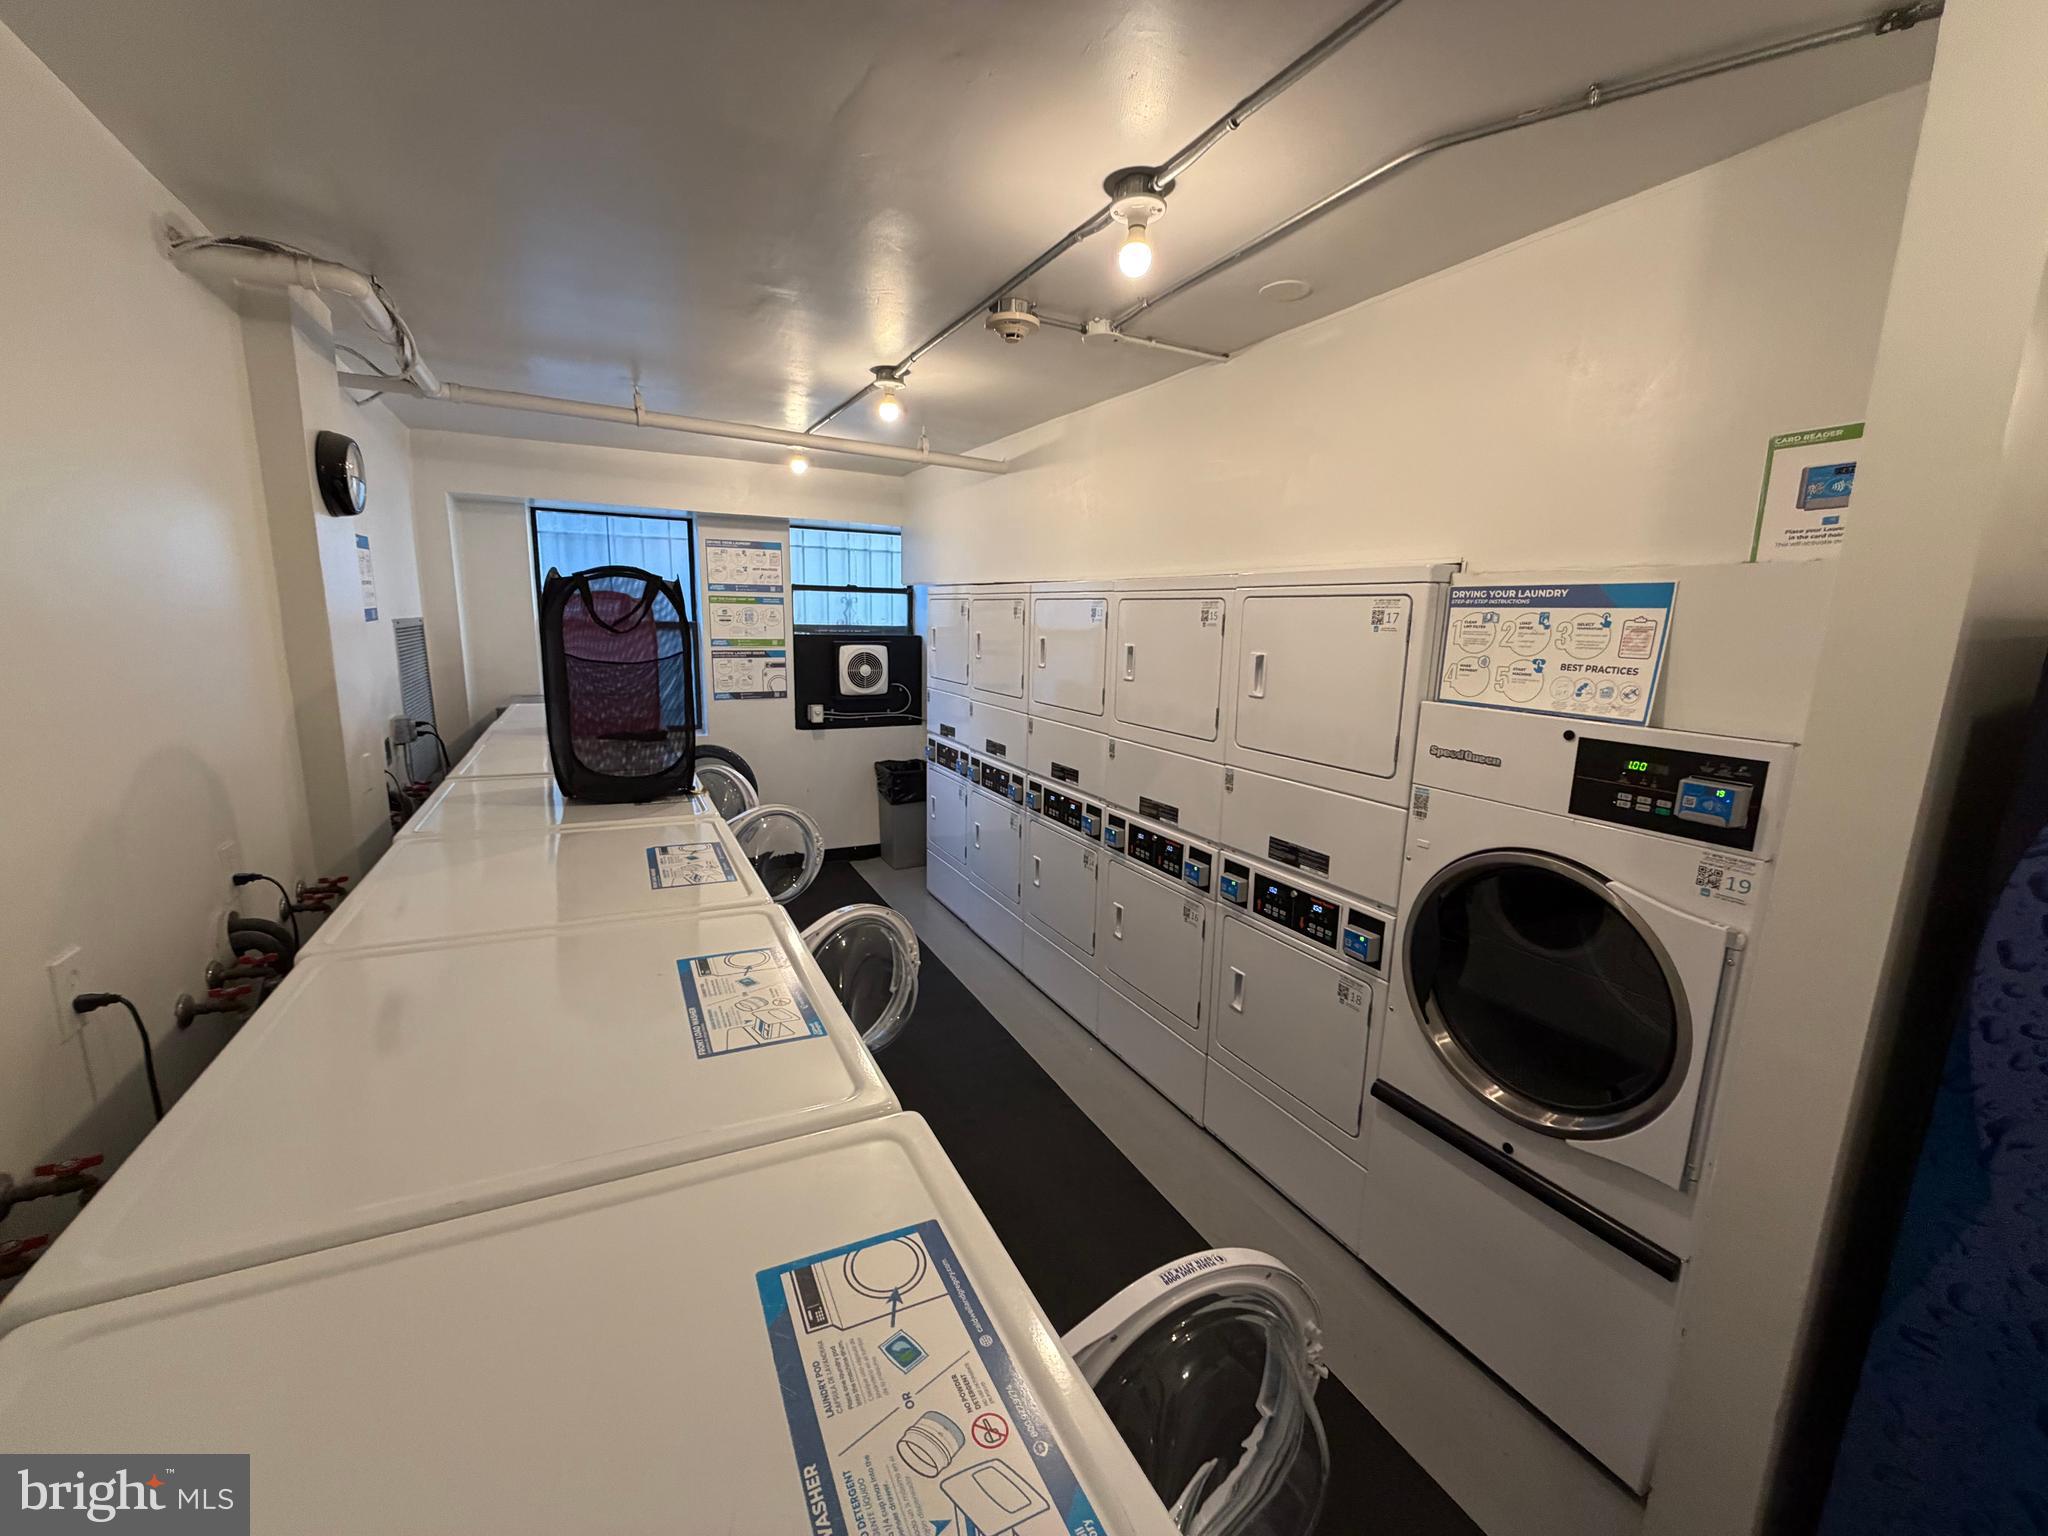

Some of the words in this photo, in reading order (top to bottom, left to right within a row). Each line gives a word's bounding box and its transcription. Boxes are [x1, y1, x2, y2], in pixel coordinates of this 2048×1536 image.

[1775, 435, 1801, 444] CARD
[1803, 429, 1844, 441] READER
[1452, 590, 1488, 599] DRYING
[1488, 589, 1517, 598] YOUR
[1517, 588, 1569, 598] LAUNDRY
[1386, 612, 1400, 625] 17
[1560, 663, 1585, 672] BEST
[1585, 664, 1640, 676] PRACTICES
[1429, 744, 1464, 760] Speed
[1464, 750, 1502, 767] Queen
[1628, 760, 1648, 772] 1.00
[1725, 876, 1751, 894] 19
[811, 1360, 823, 1379] POD
[951, 1373, 966, 1403] POWDER
[960, 1374, 982, 1411] DETERGENT
[817, 1379, 835, 1419] LAUNDRY
[901, 1391, 915, 1410] OR
[963, 1402, 974, 1414] NO
[842, 1470, 867, 1532] DETERGENT
